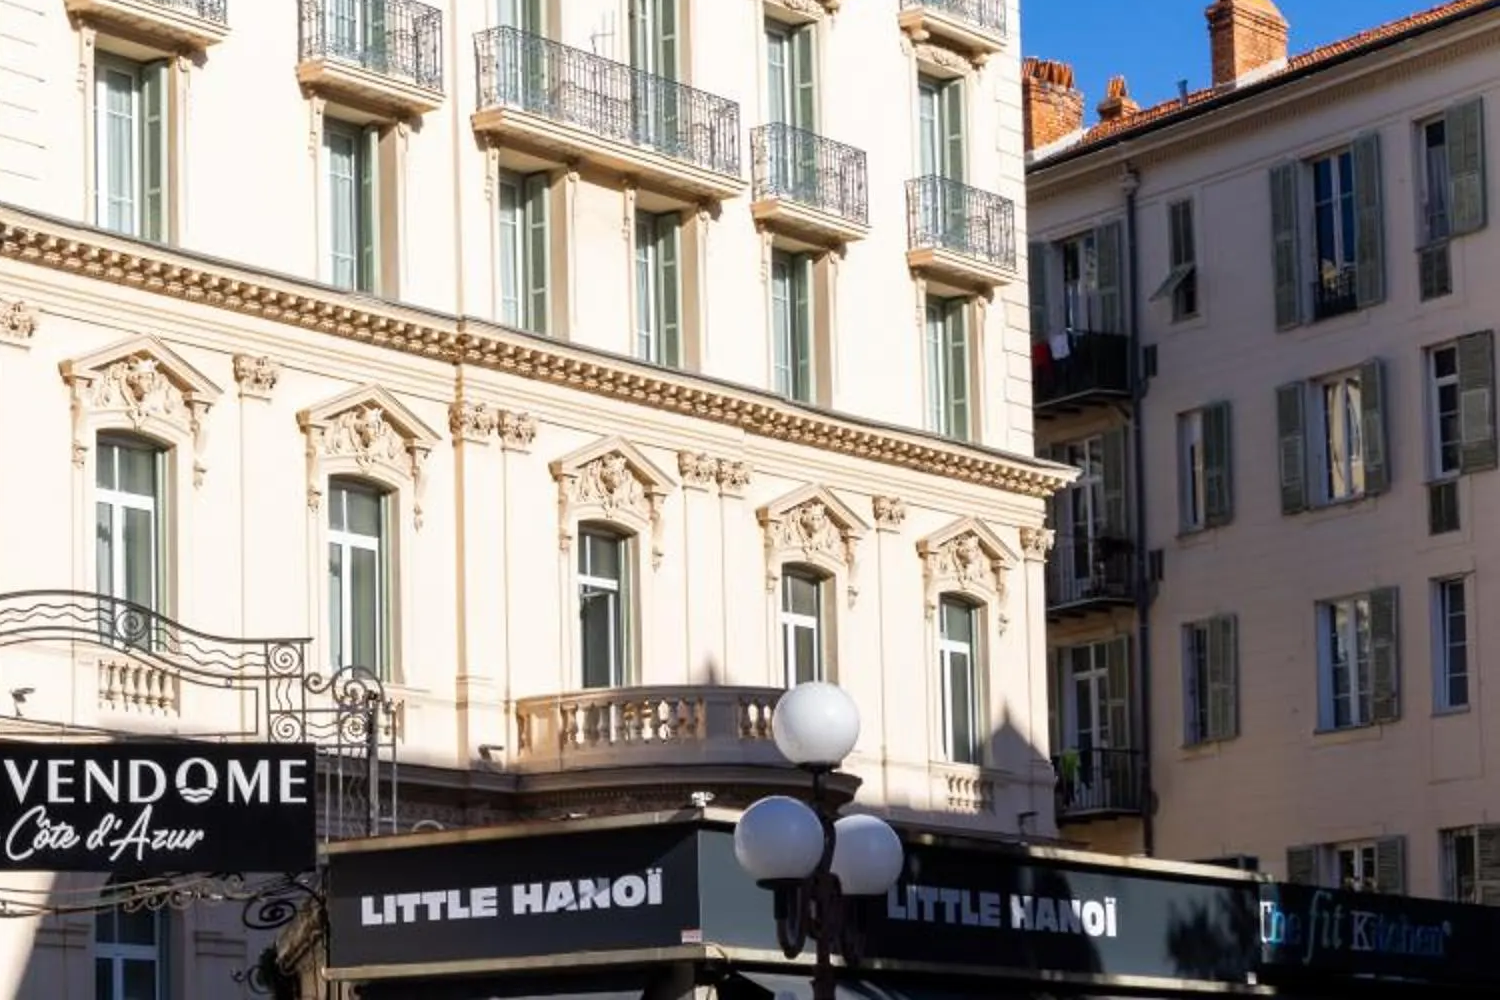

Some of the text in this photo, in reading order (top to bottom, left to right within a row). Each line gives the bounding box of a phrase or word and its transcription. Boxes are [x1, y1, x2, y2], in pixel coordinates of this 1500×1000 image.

[3, 757, 308, 803] VENDOME
[5, 805, 80, 861] Côte
[86, 805, 205, 861] d'Azur
[361, 868, 663, 926] LITTLE HANOÏ
[887, 885, 1117, 938] LITTLE HANOÏ
[1301, 889, 1347, 965] fit
